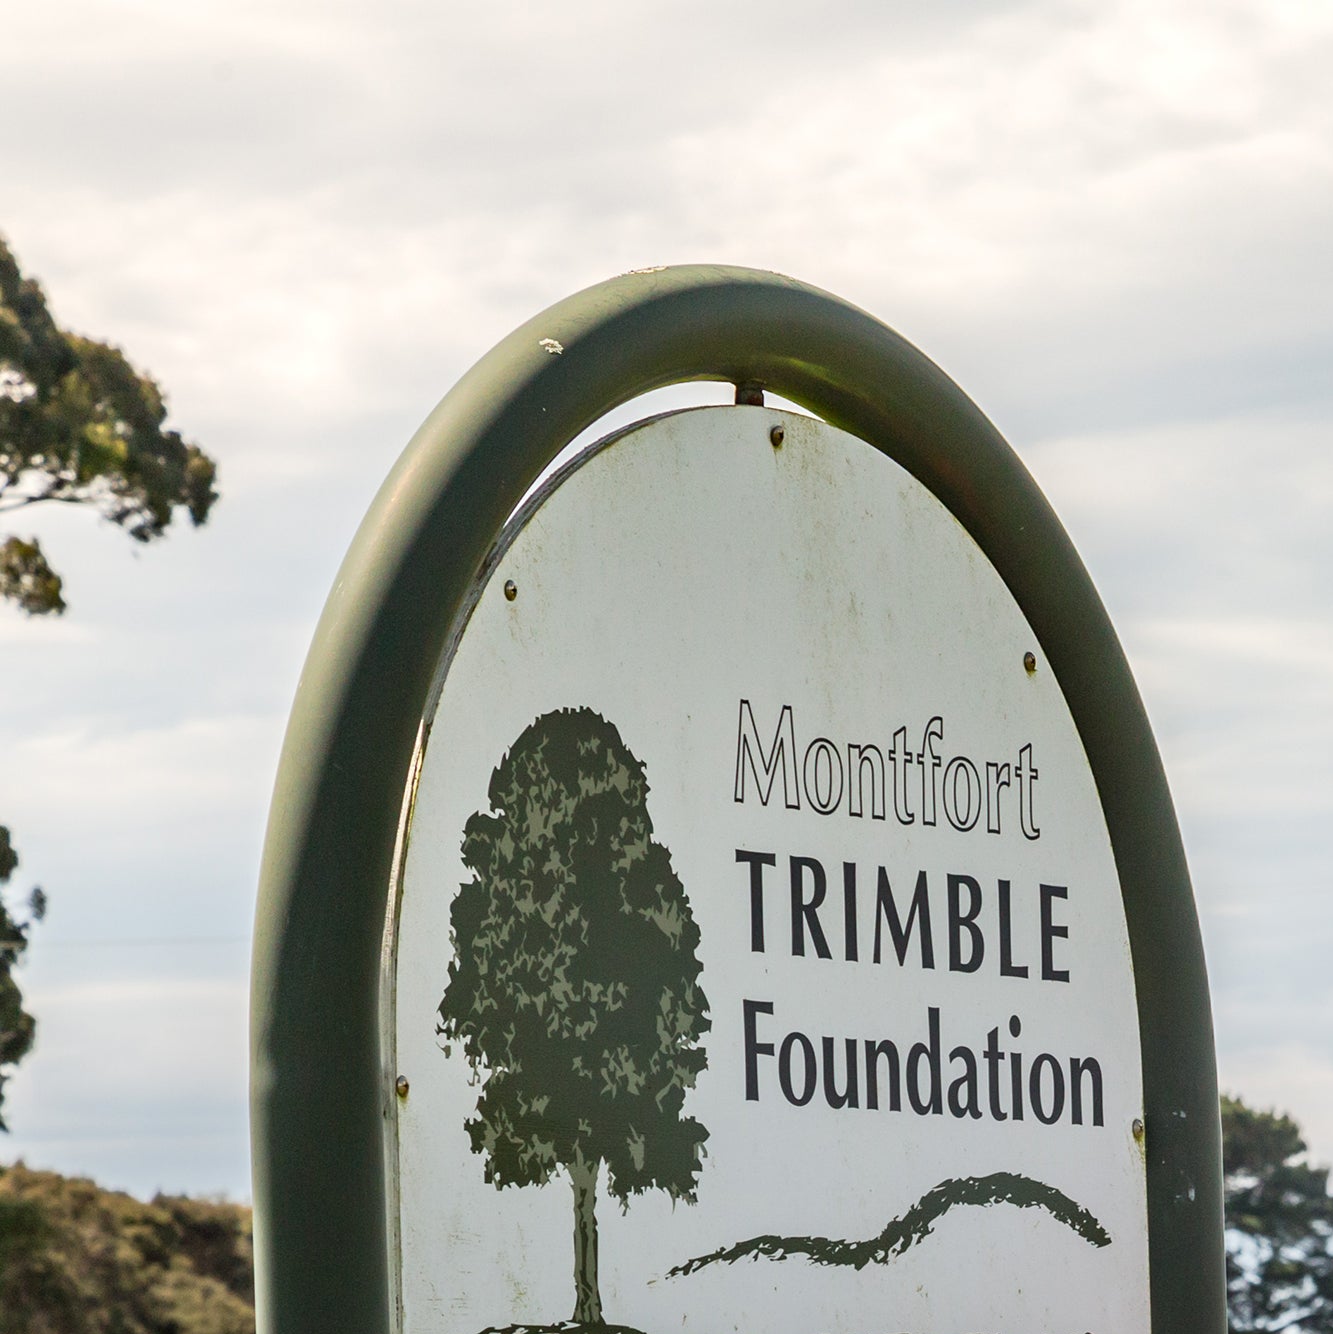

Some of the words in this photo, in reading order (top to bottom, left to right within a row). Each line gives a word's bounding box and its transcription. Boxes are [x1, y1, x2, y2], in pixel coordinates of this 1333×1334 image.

[734, 699, 1041, 841] Montfort
[735, 849, 1070, 983] TRIMBLE
[742, 999, 1105, 1128] Foundation
